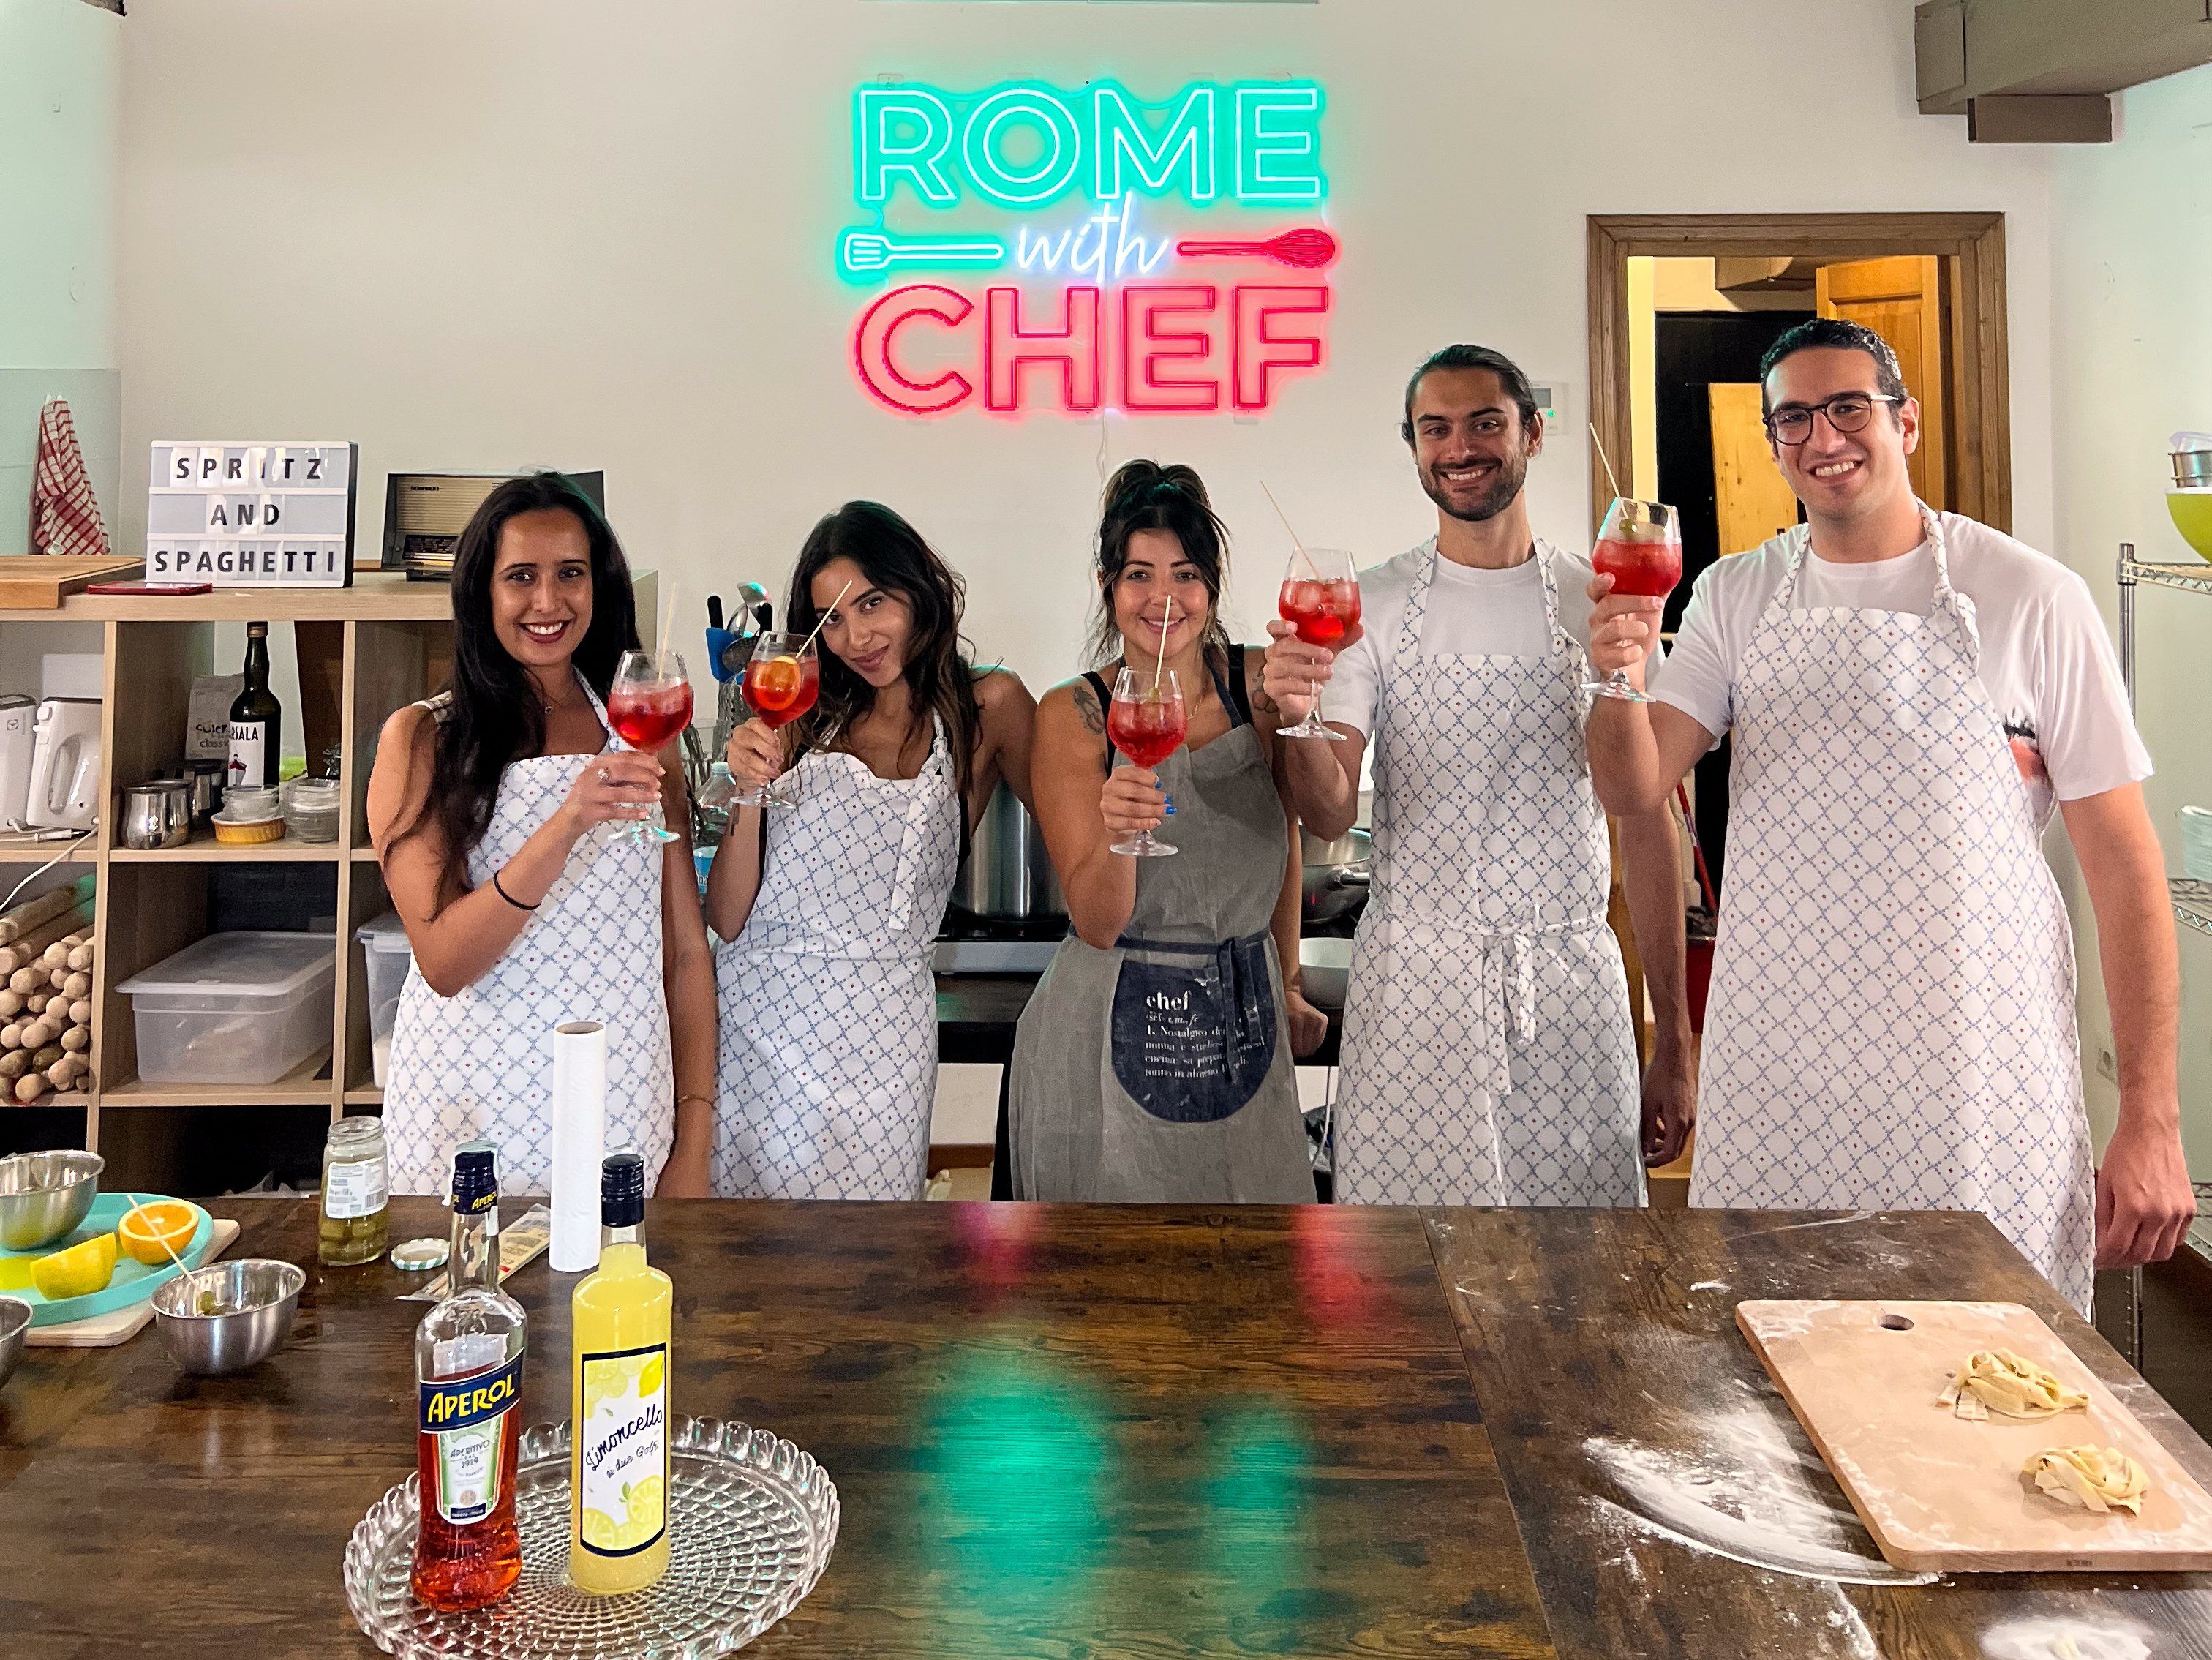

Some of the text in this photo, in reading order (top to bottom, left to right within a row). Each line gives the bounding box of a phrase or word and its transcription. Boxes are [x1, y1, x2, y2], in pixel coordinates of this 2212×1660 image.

[859, 87, 1321, 203] ROME
[1017, 190, 1170, 284] with
[854, 283, 1329, 413] CHEF
[176, 457, 322, 480] SPRITZ
[209, 503, 280, 525] AND
[154, 550, 334, 572] SPAGHETTI
[1146, 990, 1192, 1010] chef
[427, 1373, 515, 1424] APEROL
[450, 1439, 490, 1457] APERITIVO
[585, 1403, 663, 1471] Limoncello
[461, 1457, 479, 1468] 1919
